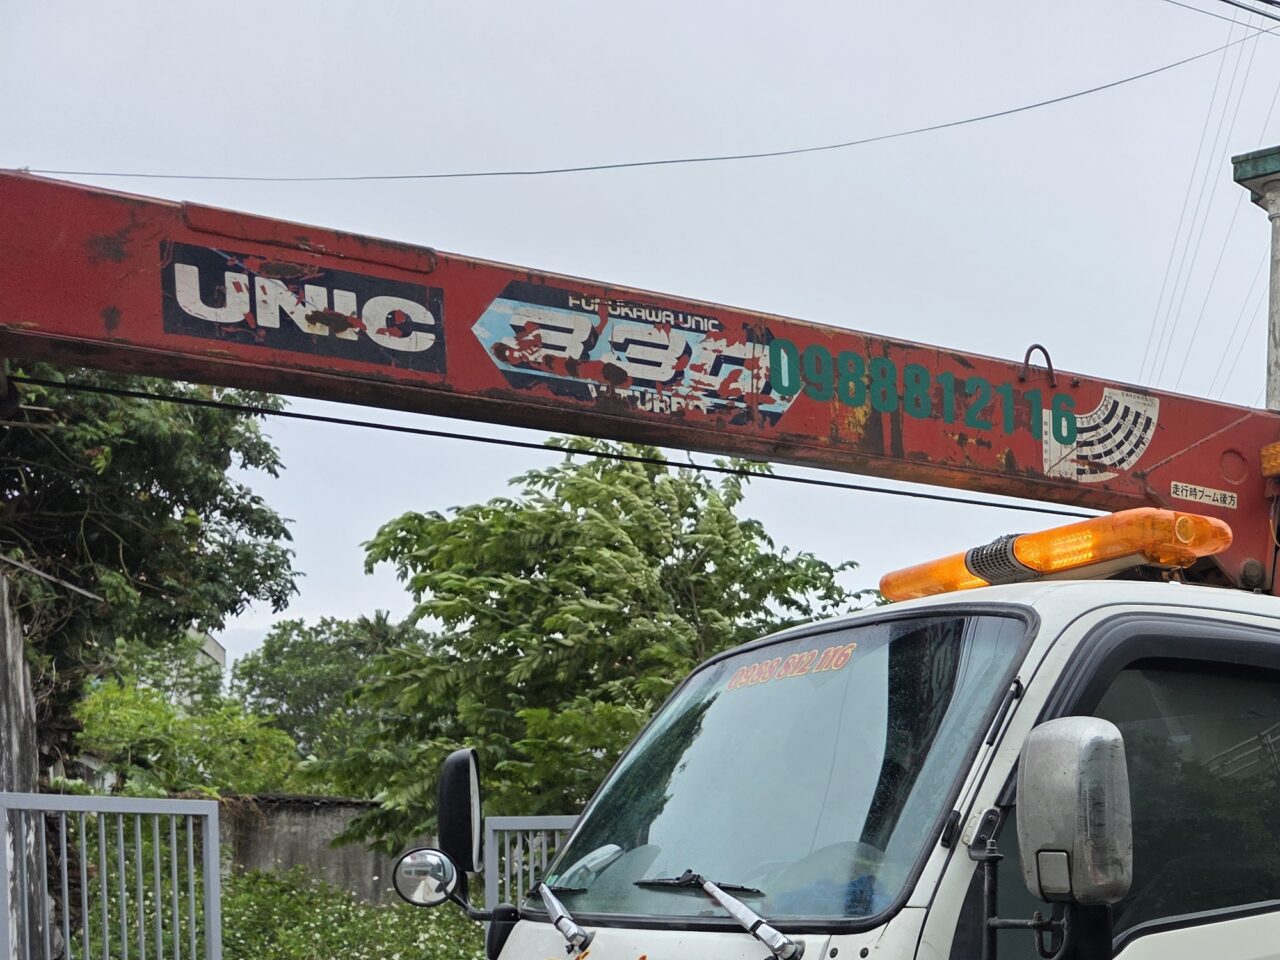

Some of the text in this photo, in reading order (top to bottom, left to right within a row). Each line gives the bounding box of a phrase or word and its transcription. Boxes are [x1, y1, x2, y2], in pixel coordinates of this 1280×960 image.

[174, 263, 436, 352] UNIC
[678, 313, 720, 332] UNIC
[769, 338, 1077, 446] 0988812116
[1171, 481, 1237, 507] 走行時ブーム後方
[727, 643, 857, 691] 0988 812 116
